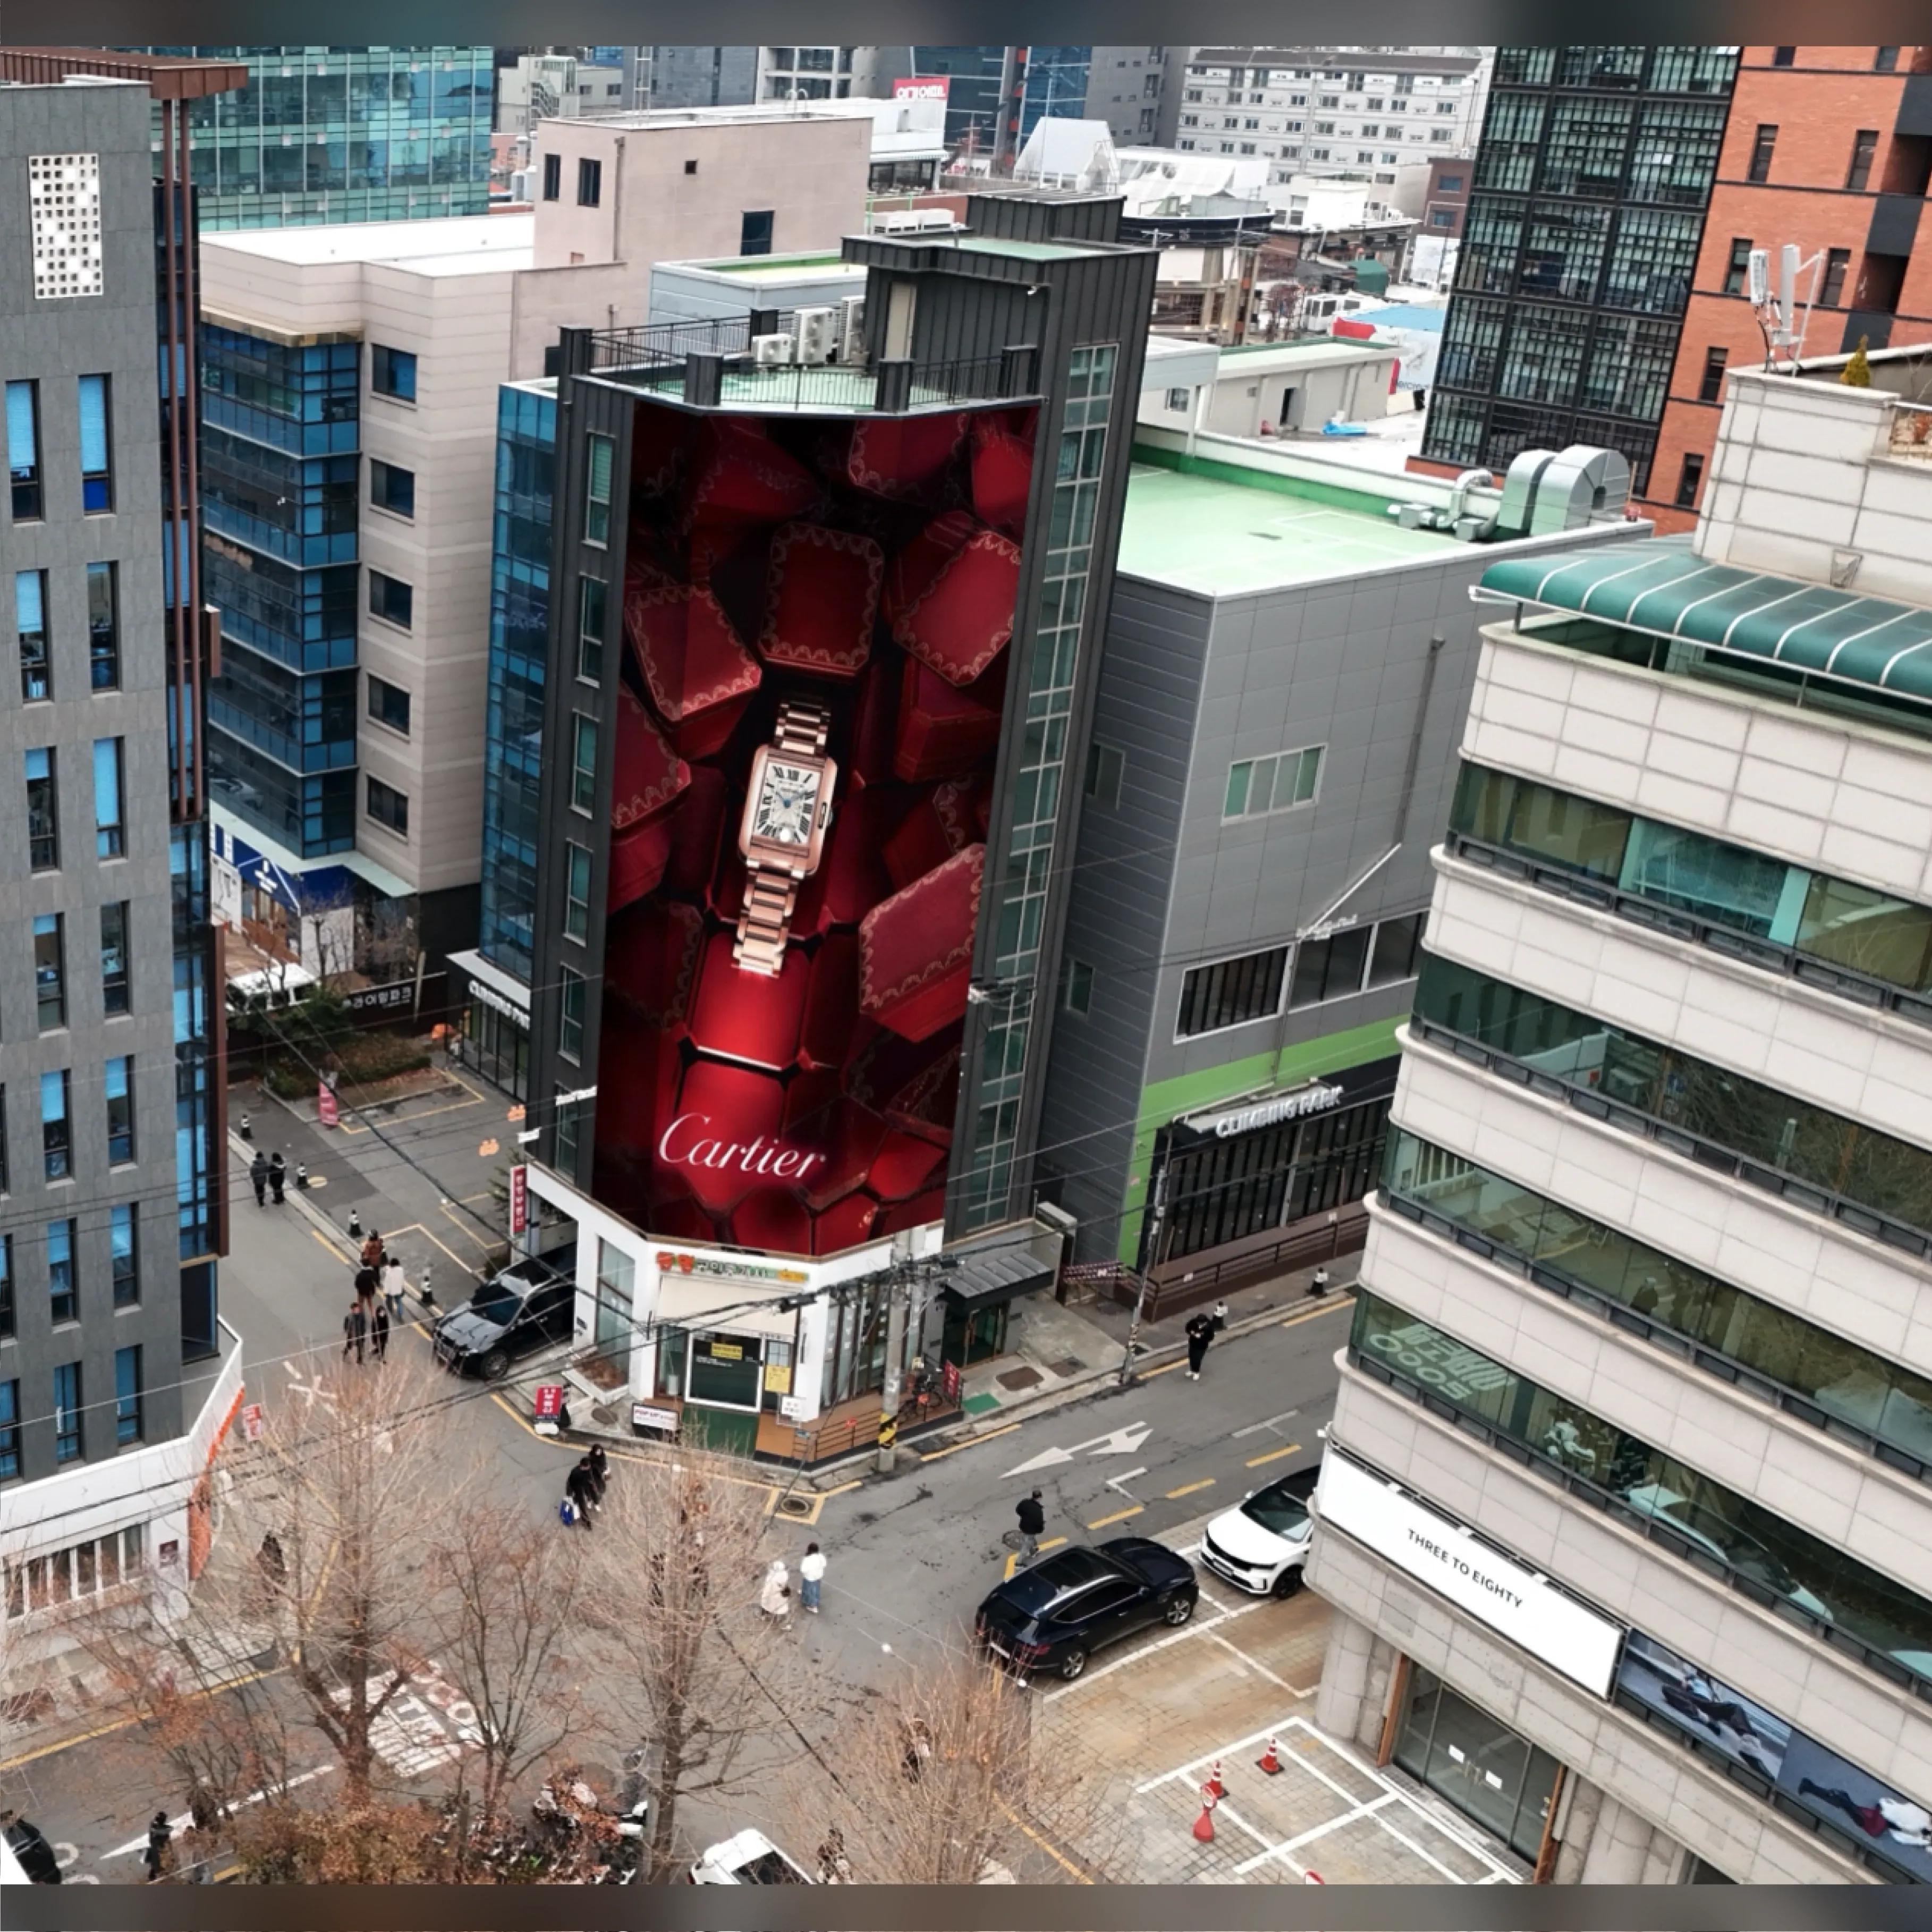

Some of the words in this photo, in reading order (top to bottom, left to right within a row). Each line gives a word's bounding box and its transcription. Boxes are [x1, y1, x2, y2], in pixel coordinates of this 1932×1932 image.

[1216, 1099, 1295, 1138] CLIMBING
[1299, 1085, 1344, 1115] PARK
[659, 1113, 827, 1177] Cartier
[1408, 1528, 1449, 1563] THREE
[1453, 1557, 1470, 1574] TO
[1472, 1570, 1523, 1608] EIGHTY
